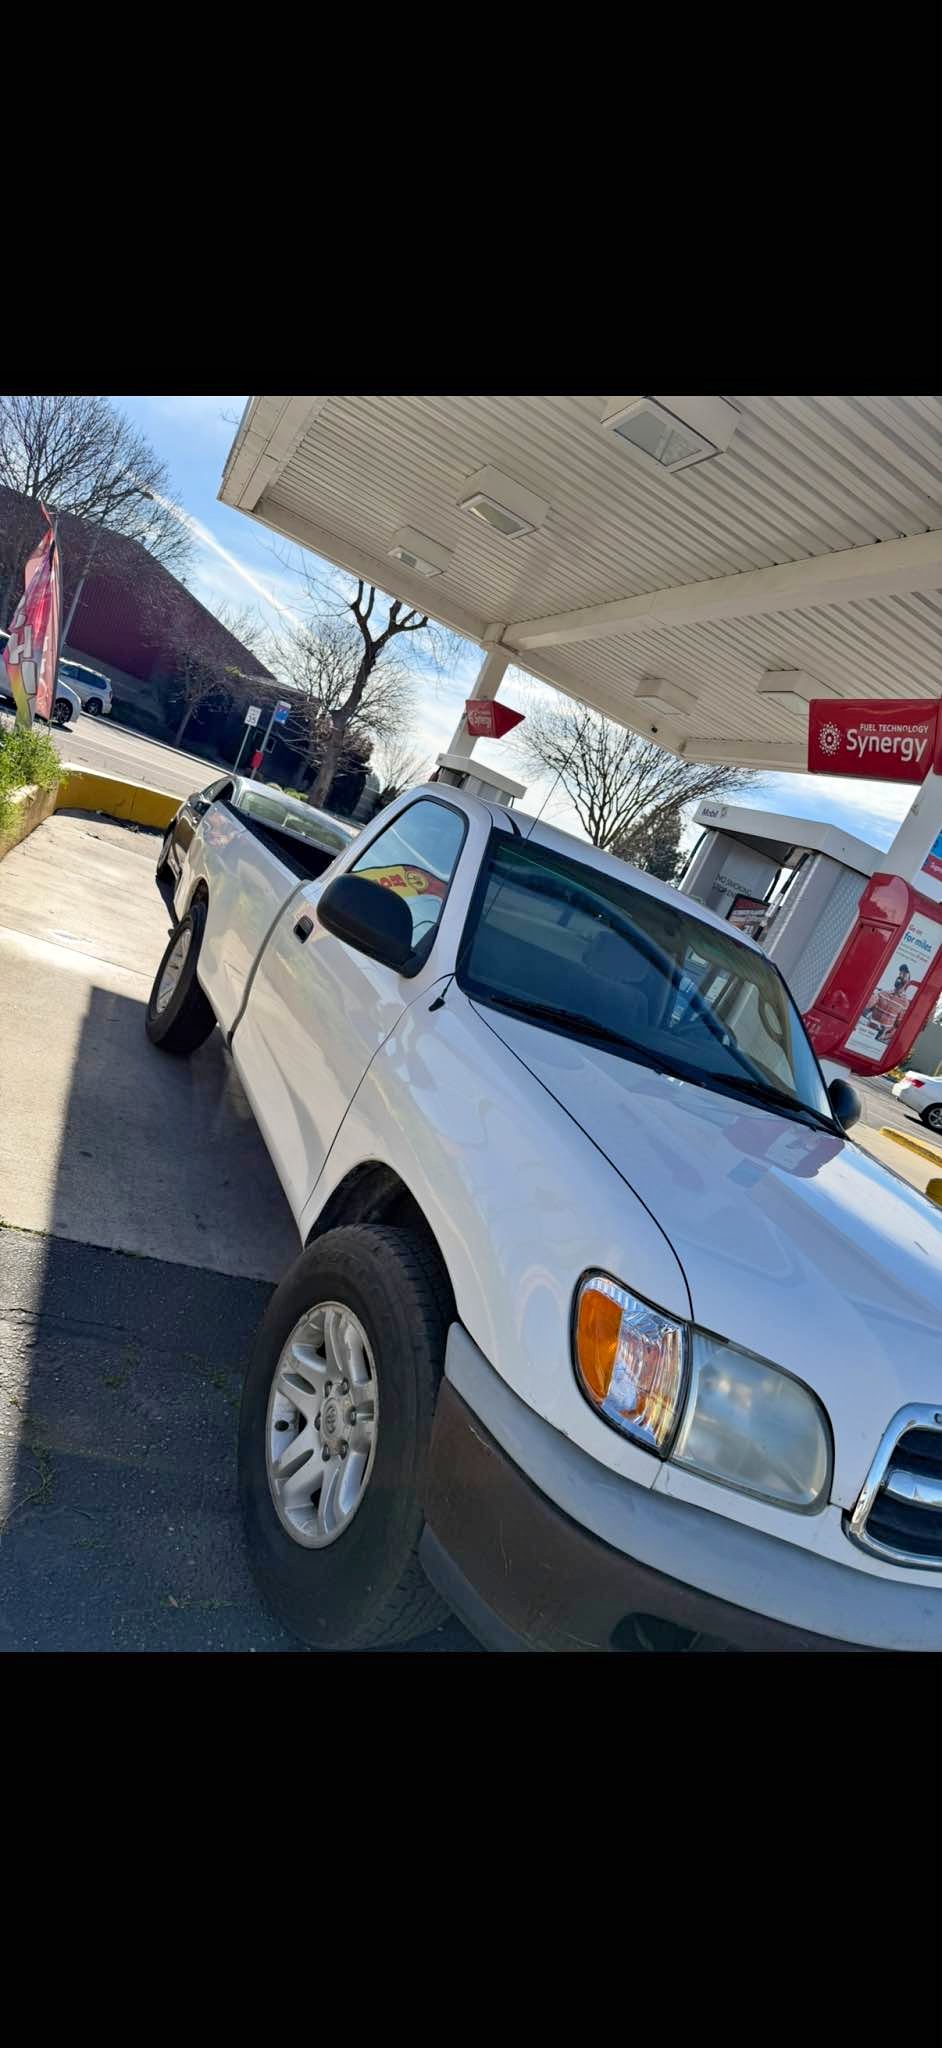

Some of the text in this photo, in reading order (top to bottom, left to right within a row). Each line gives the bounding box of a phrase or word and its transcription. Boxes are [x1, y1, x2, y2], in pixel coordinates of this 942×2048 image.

[860, 723, 929, 734] FUEL TECHNOLOGY
[846, 728, 928, 762] Synergy
[702, 807, 719, 818] Mobil
[903, 931, 932, 953] for miles
